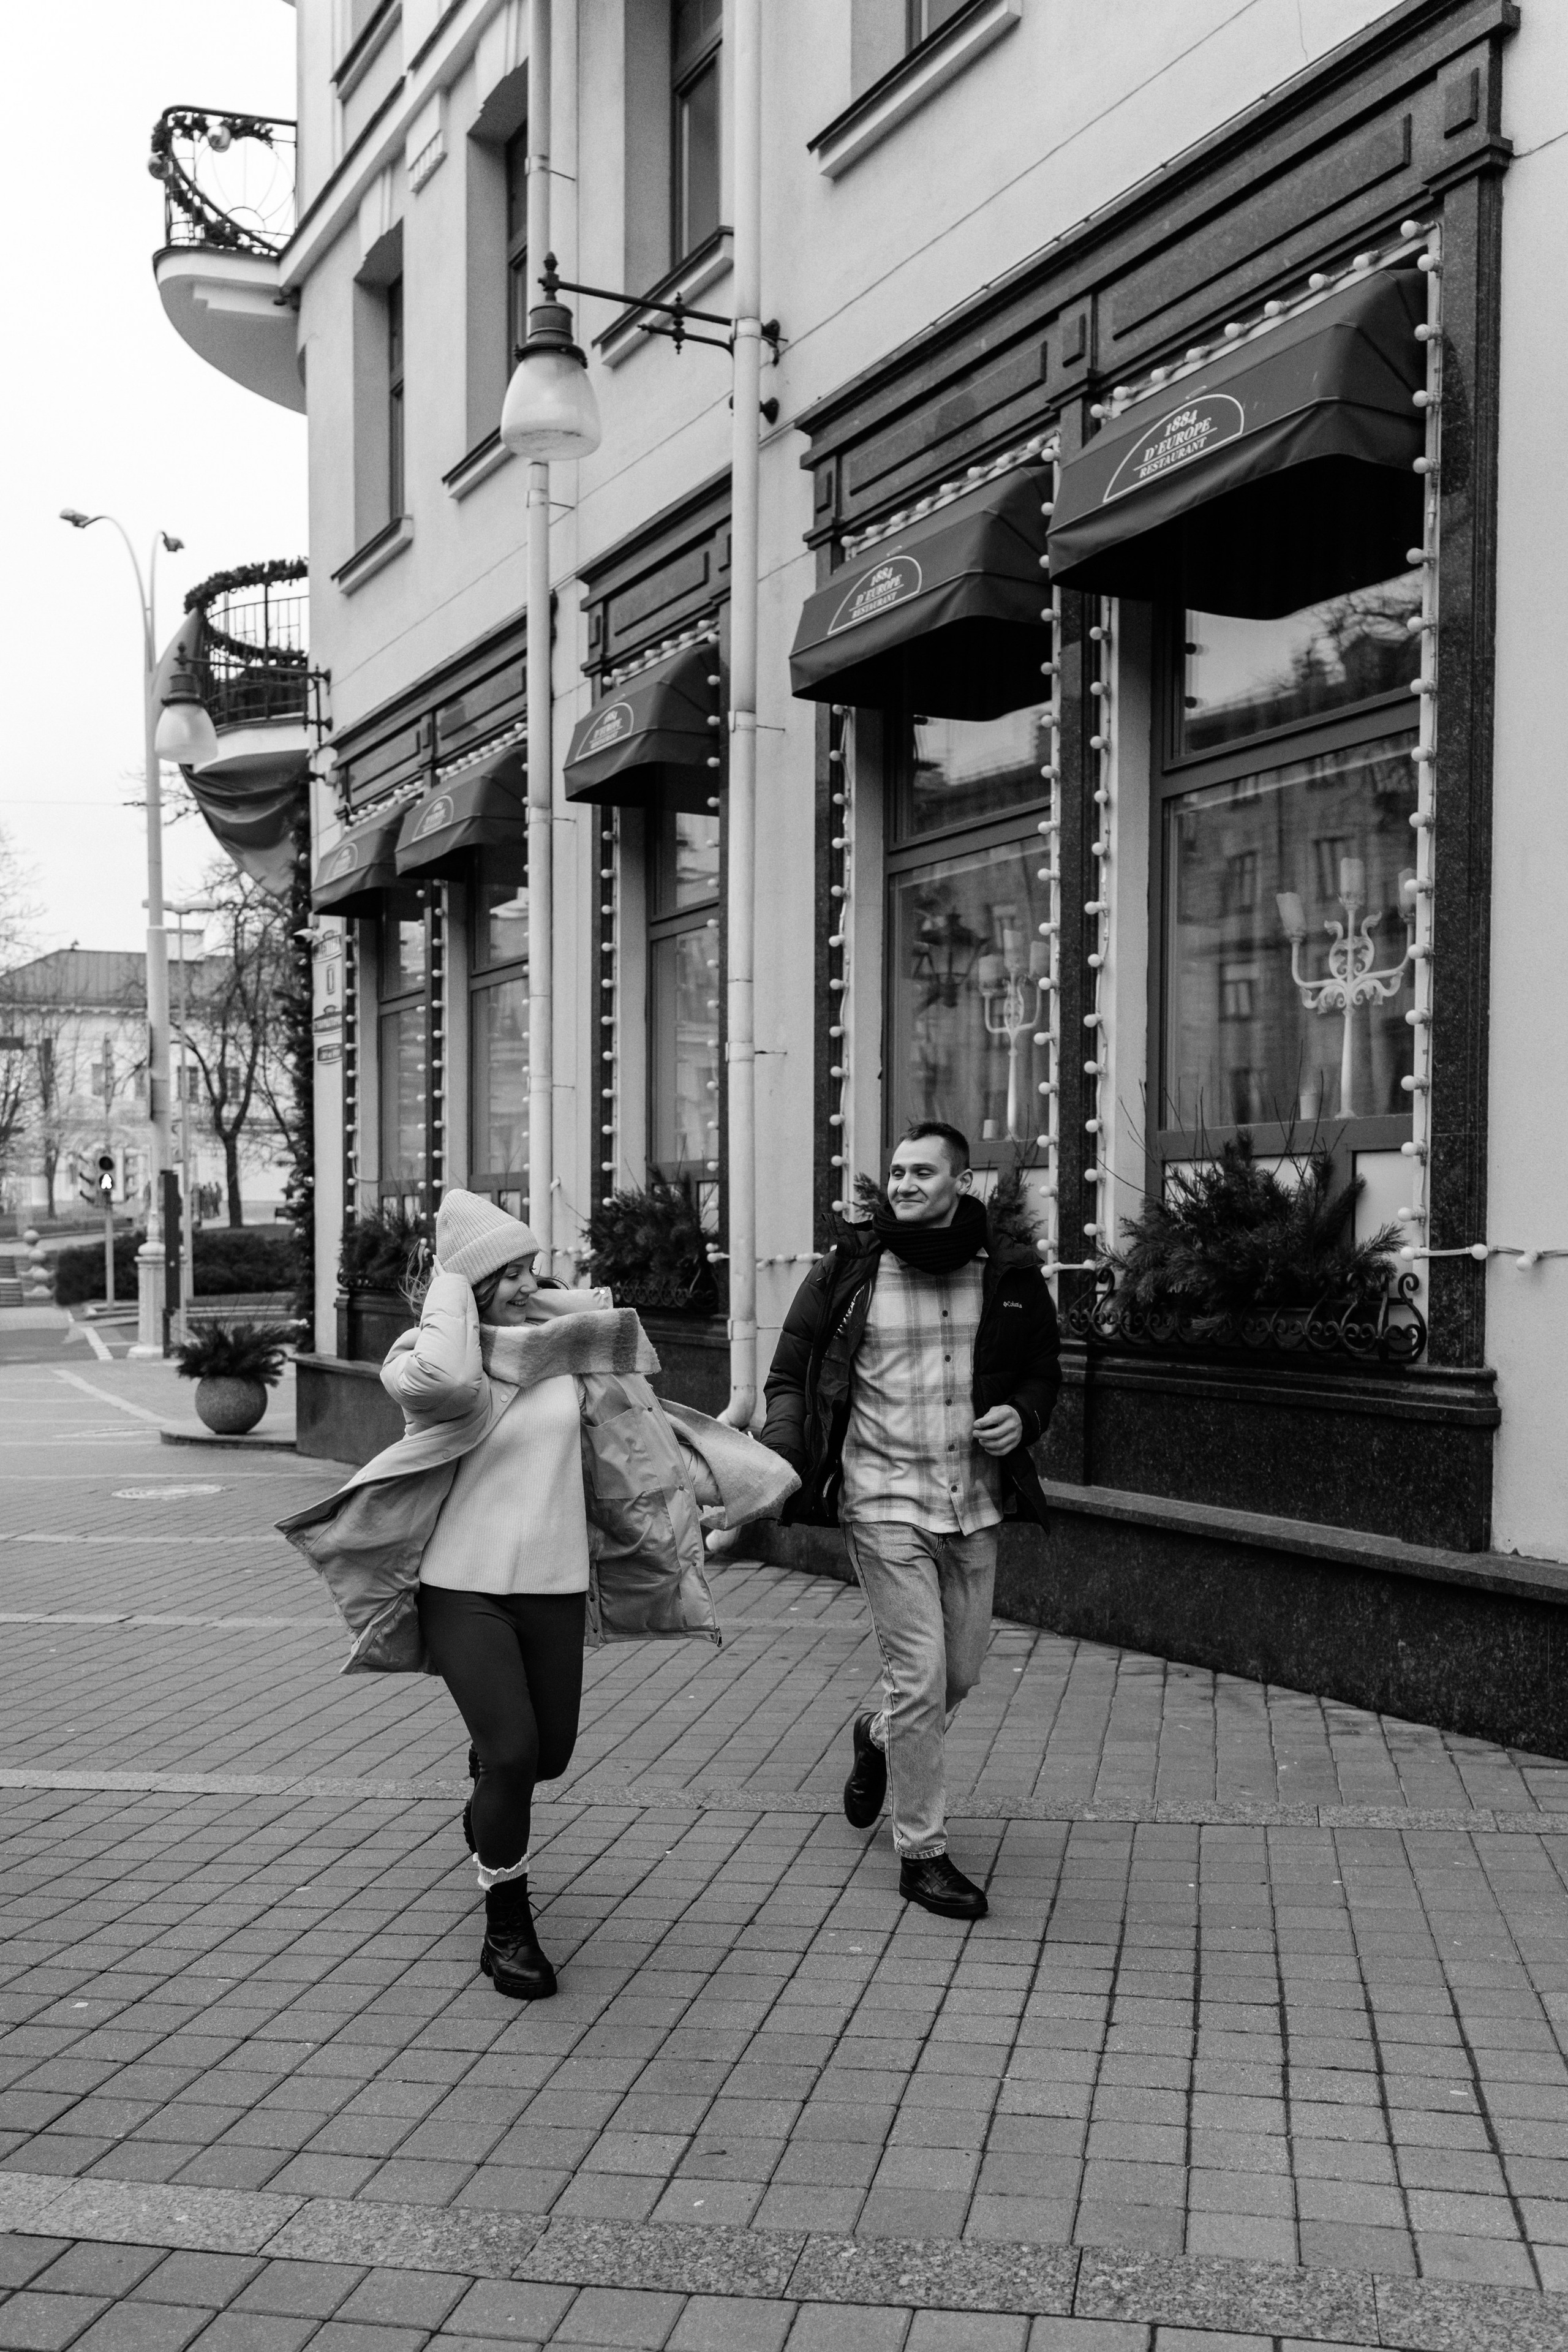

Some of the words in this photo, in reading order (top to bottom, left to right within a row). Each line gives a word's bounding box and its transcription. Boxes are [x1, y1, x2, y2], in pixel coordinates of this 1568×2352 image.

[1143, 417, 1212, 462] D'EUROPE
[1164, 410, 1198, 437] 1884
[1139, 437, 1207, 478] RESTAURANT
